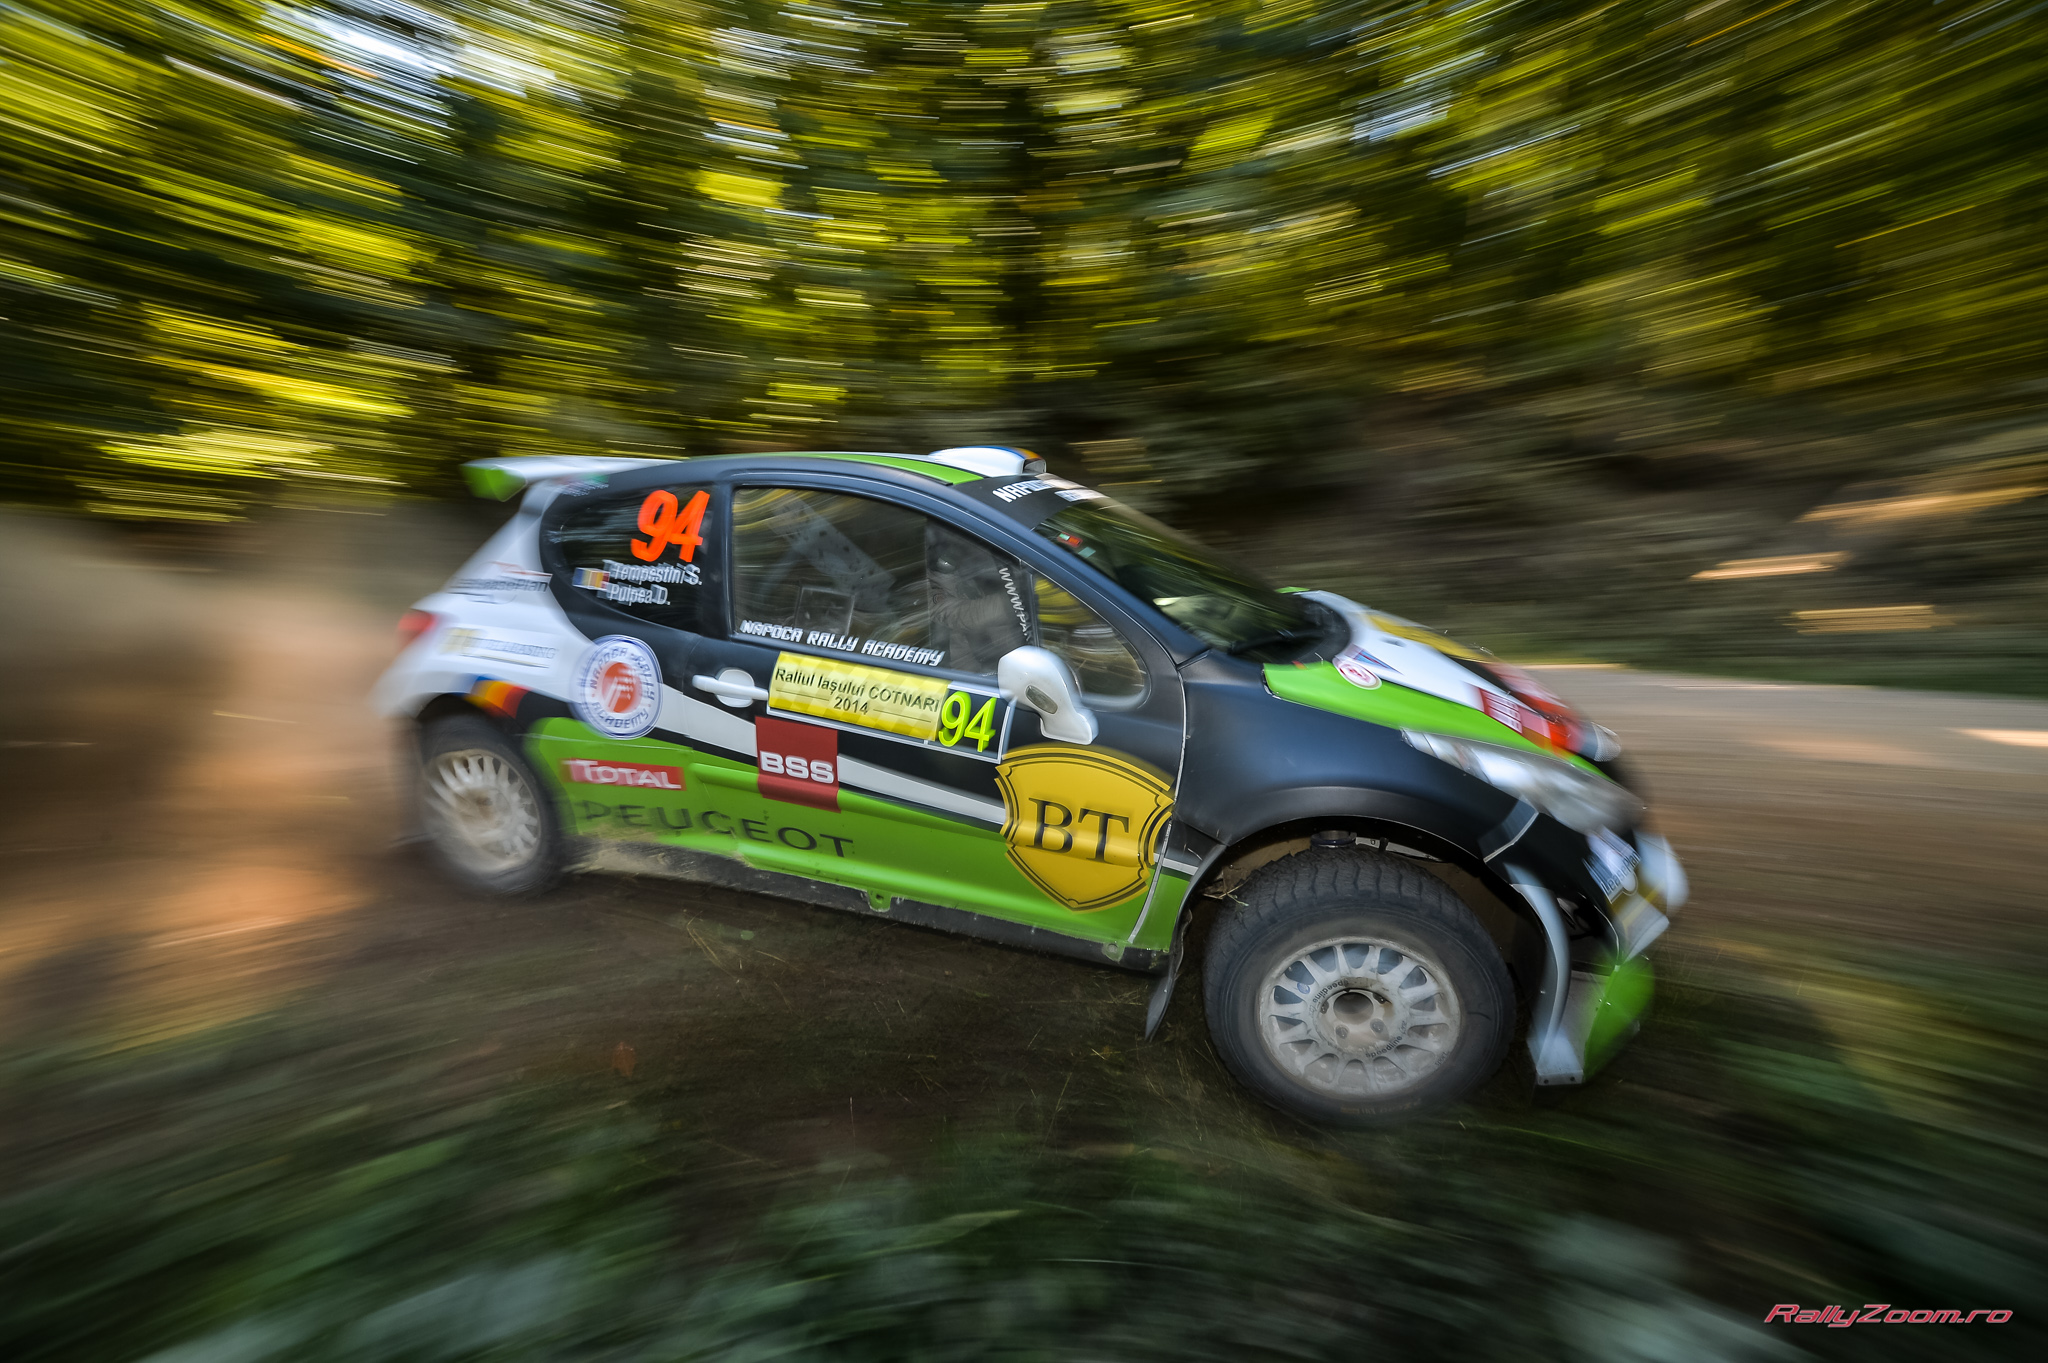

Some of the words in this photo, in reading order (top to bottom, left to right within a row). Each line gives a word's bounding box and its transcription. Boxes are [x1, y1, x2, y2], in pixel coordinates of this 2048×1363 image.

[630, 490, 710, 562] 94
[602, 559, 685, 585] Tempestini
[740, 620, 803, 643] NAPOCA
[807, 631, 859, 652] RALLY
[861, 640, 945, 667] ACADEMY
[775, 668, 815, 687] Raliul
[869, 684, 940, 713] COTNARI
[833, 696, 870, 715] 2014
[938, 690, 996, 752] 94
[568, 759, 682, 789] TOTAL
[759, 750, 835, 784] BSS
[578, 799, 853, 857] PEUGEOT
[1025, 797, 1130, 865] BT
[1365, 1035, 1403, 1058] speedline
